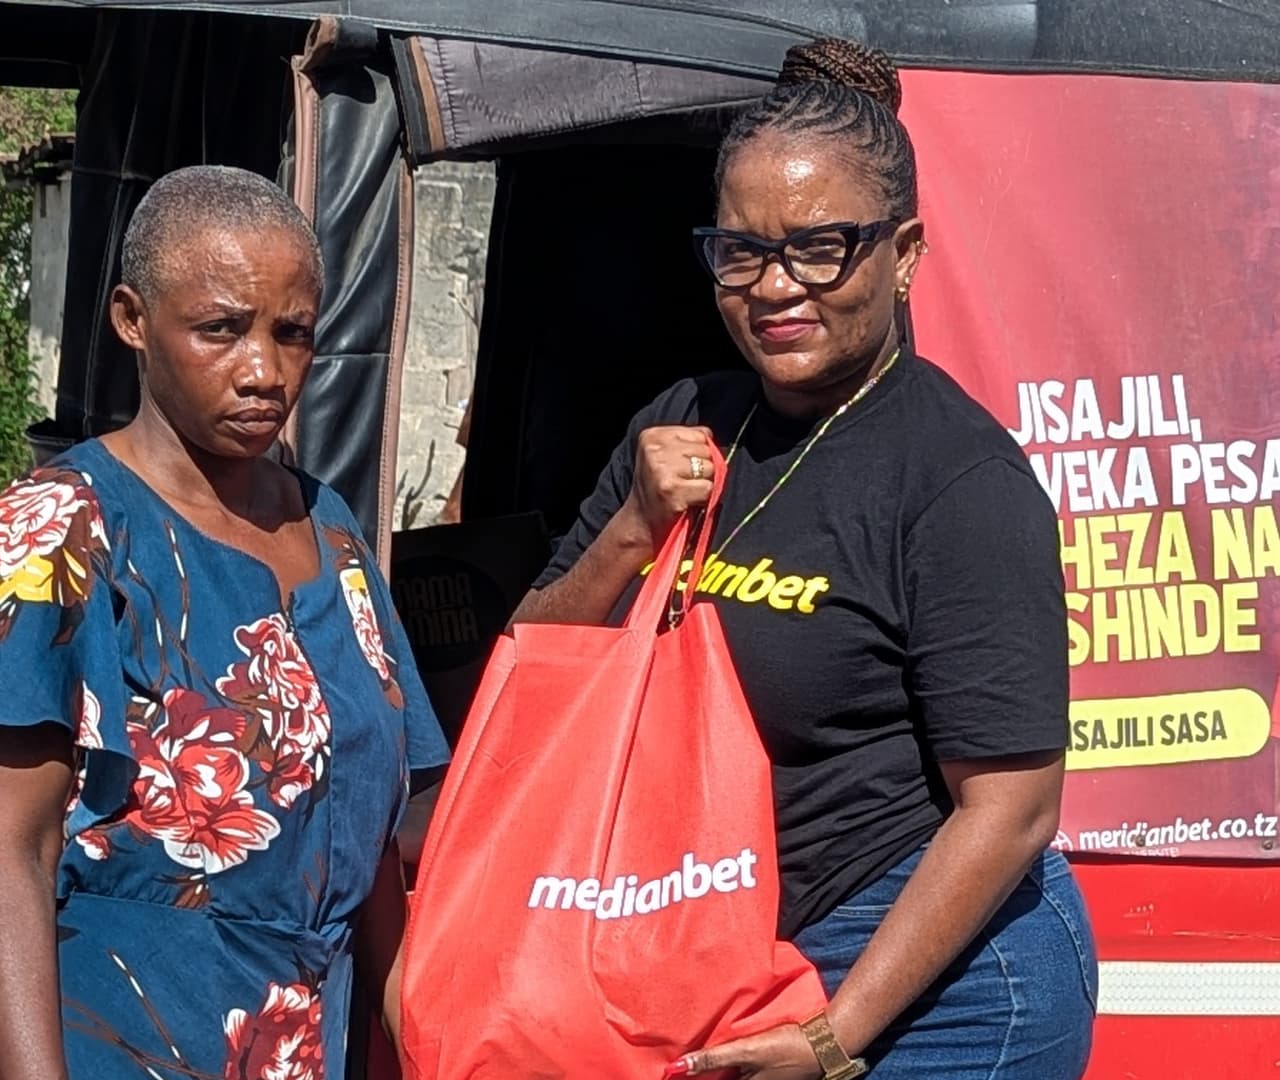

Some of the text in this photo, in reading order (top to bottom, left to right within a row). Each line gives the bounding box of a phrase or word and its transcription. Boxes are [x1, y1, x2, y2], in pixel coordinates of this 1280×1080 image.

[1007, 374, 1202, 446] JISAJILI,
[1057, 510, 1197, 590] HEZA
[1065, 581, 1261, 667] SHINDE
[1066, 710, 1228, 752] ISAJILI SASA
